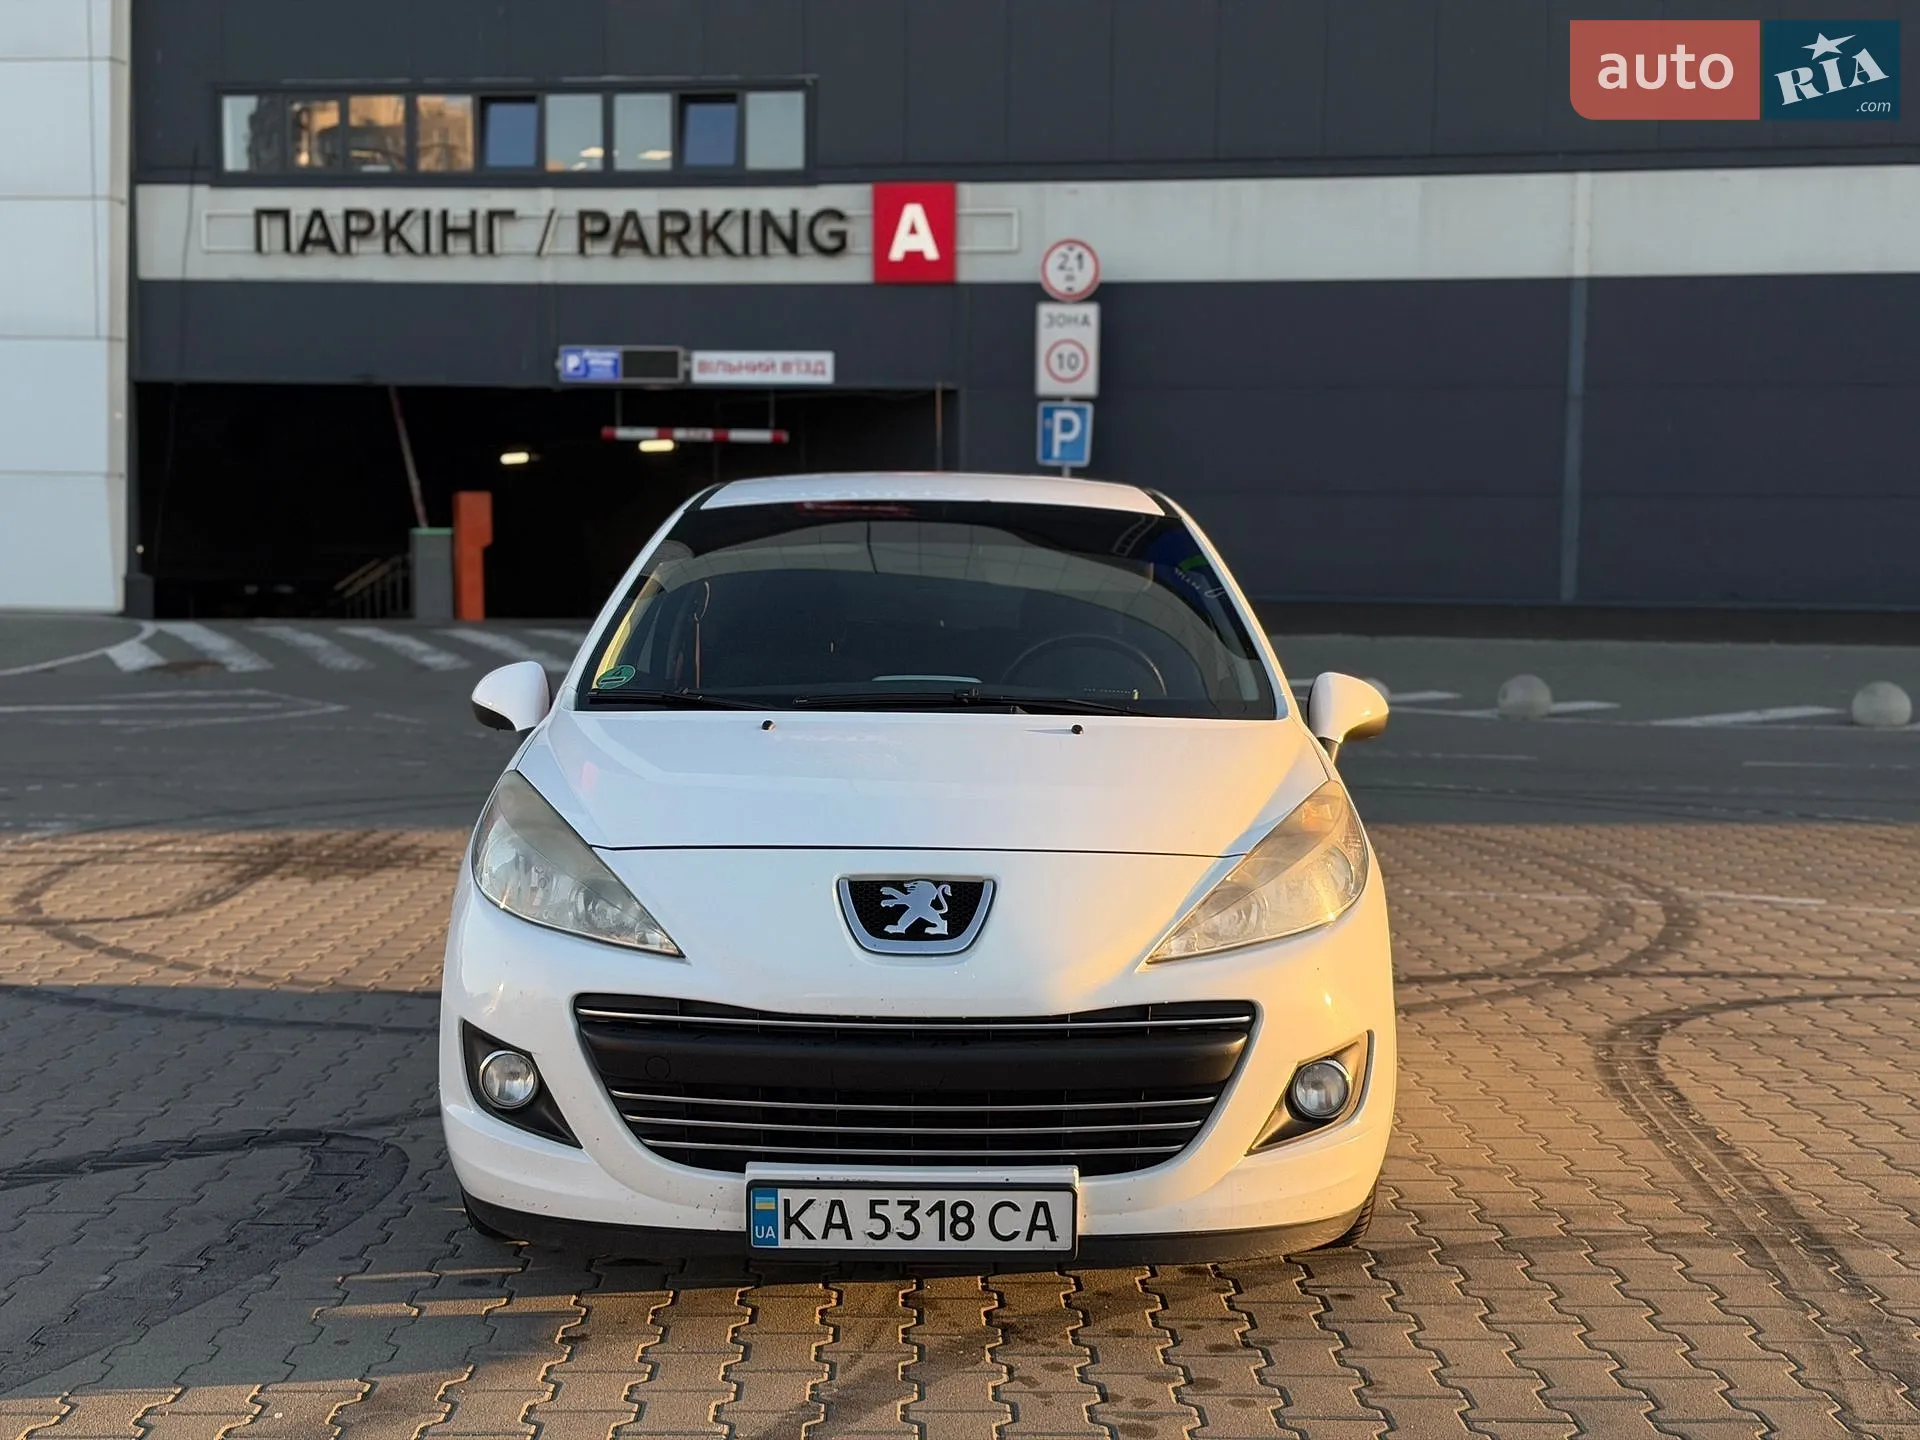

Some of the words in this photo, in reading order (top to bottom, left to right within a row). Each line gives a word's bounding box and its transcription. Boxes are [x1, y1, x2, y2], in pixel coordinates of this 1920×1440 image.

[254, 208, 517, 256] ПАРКІНГ
[577, 208, 849, 257] PARKING
[888, 203, 940, 261] A
[1045, 313, 1092, 328] ЗОНА
[1056, 353, 1080, 371] 10
[1052, 409, 1082, 458] P
[755, 1225, 776, 1240] UA
[783, 1198, 853, 1241] KA
[866, 1199, 975, 1242] 5318
[988, 1200, 1058, 1242] CA
